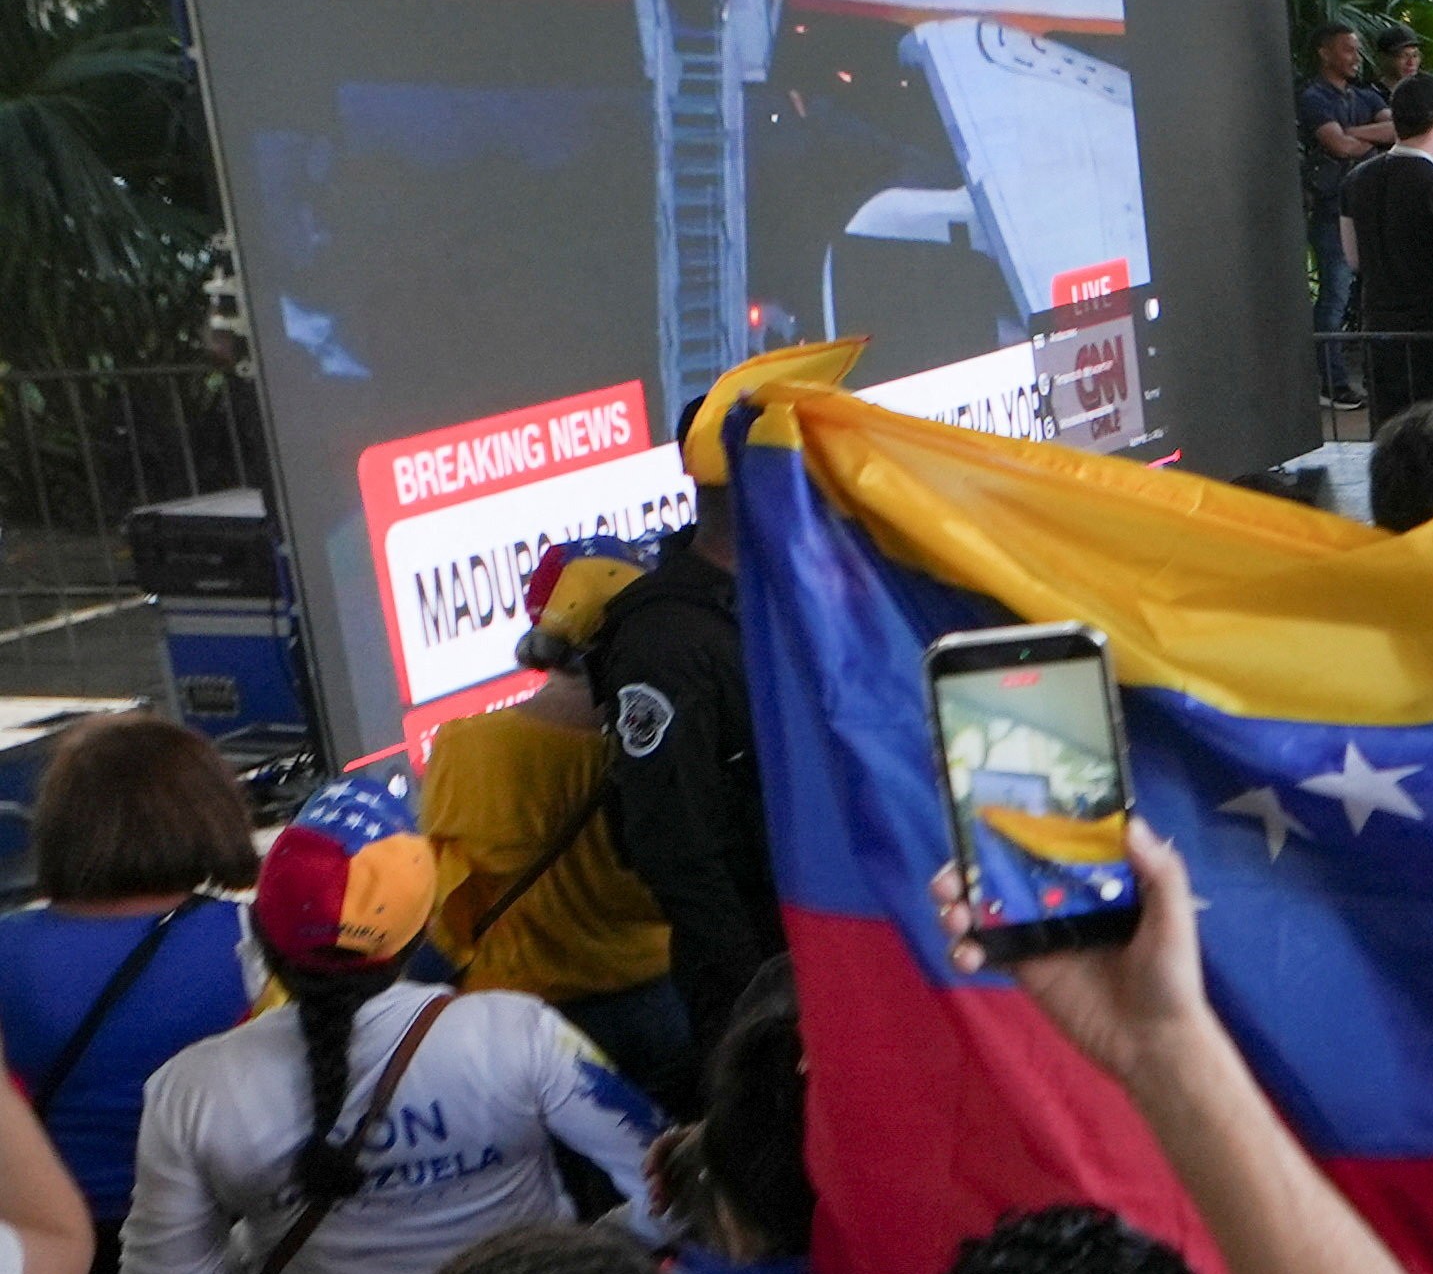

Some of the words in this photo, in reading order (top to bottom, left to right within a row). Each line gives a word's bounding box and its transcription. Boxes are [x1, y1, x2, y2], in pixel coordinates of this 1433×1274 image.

[1071, 275, 1112, 314] LIVE
[1075, 334, 1128, 413] CNN
[392, 423, 546, 506] BREAKING
[548, 401, 631, 463] NEWS
[340, 1100, 447, 1153] ON
